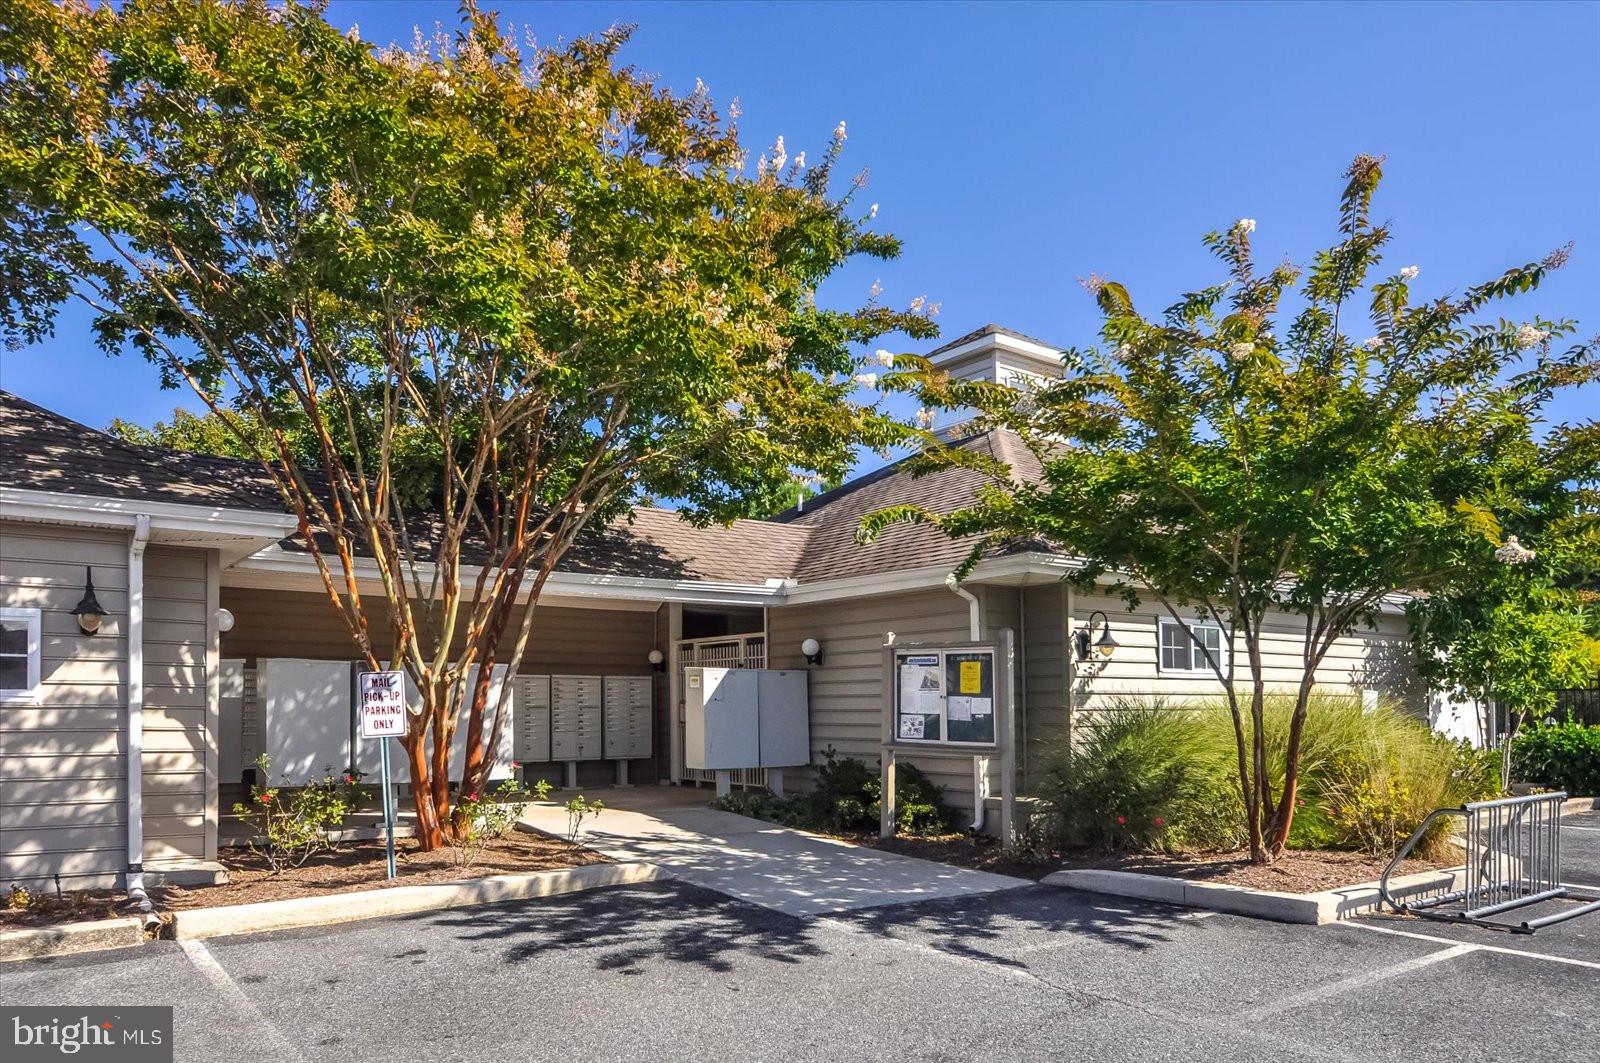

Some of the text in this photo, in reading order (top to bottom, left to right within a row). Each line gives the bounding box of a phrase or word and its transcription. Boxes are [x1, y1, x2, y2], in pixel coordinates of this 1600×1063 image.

[371, 678, 392, 688] MAIL
[364, 691, 400, 702] PICK-UP
[365, 705, 401, 716] PARKING
[373, 719, 394, 730] ONLY
